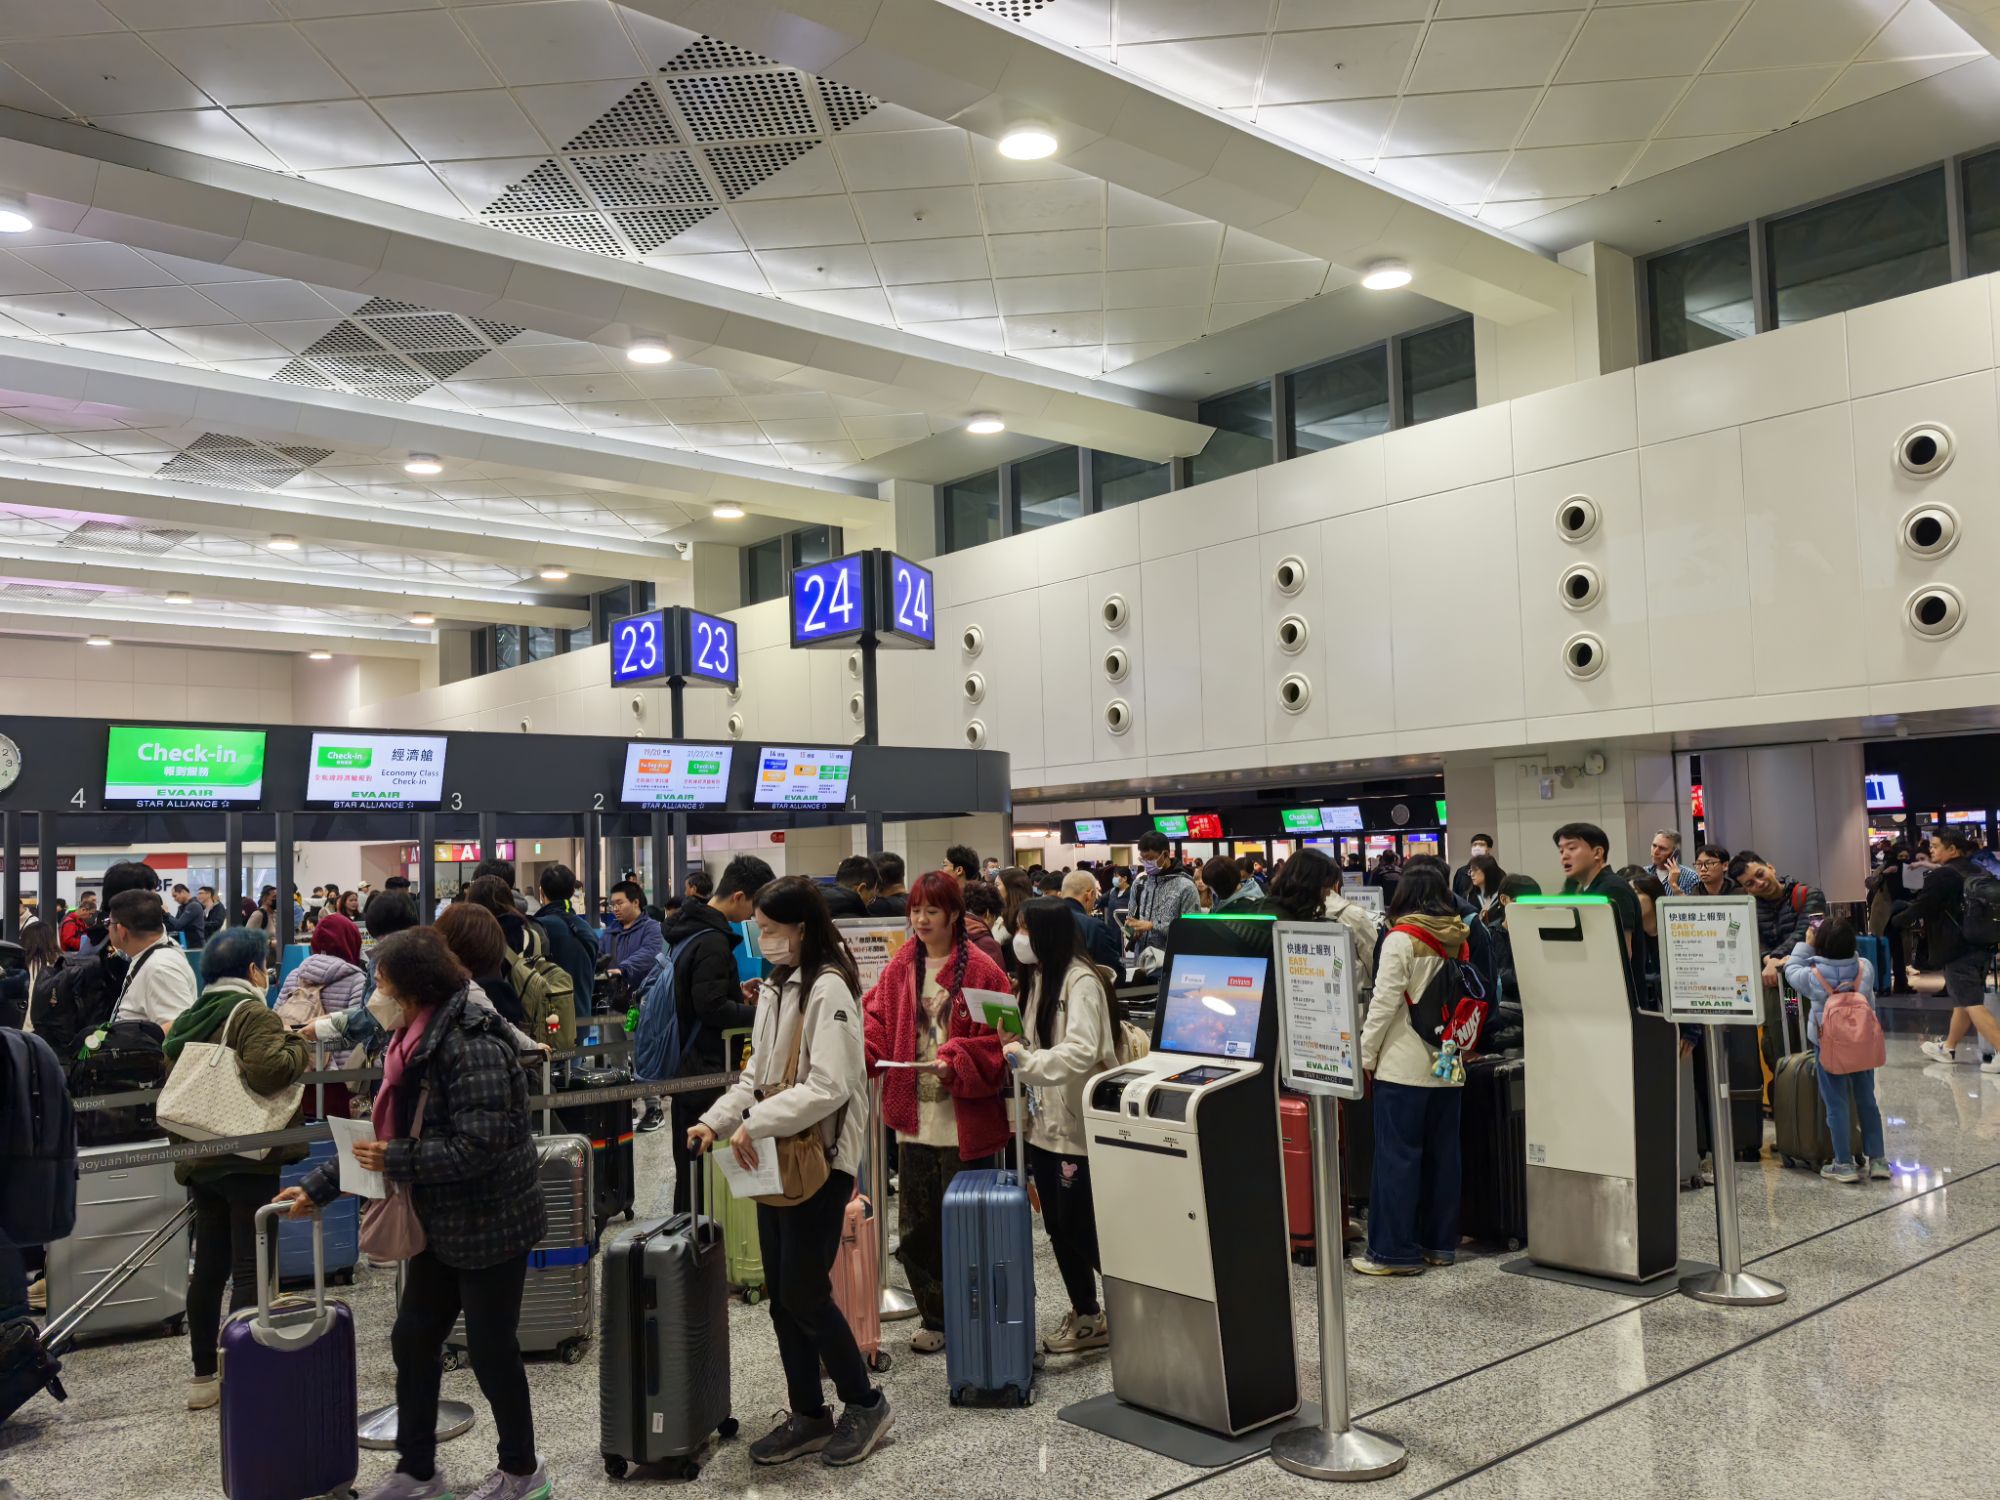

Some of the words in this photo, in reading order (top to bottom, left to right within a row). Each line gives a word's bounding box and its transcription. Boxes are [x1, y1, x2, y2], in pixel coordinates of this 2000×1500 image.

[804, 568, 853, 632] 24
[898, 568, 928, 631] 24
[621, 621, 656, 673] 23
[698, 622, 728, 673] 23
[137, 743, 237, 763] Check-in
[327, 751, 363, 761] Check-in
[391, 748, 434, 762] 經濟艙
[381, 769, 417, 778] Economy
[419, 769, 439, 777] Class
[70, 788, 86, 808] 4
[190, 789, 213, 797] AIR
[137, 800, 163, 808] STAR
[166, 800, 218, 808] ALLIANCE
[334, 801, 357, 809] STAR
[360, 801, 404, 809] ALLIANCE
[451, 792, 462, 810] 3
[593, 793, 604, 810] 2
[850, 795, 857, 809] 1
[461, 844, 507, 860] AM
[1288, 956, 1308, 965] EASY
[1289, 967, 1325, 977] CHECK-IN
[1456, 1005, 1481, 1046] NIKE
[553, 1050, 576, 1058] Airport
[1306, 1061, 1322, 1069] EVA
[1323, 1063, 1339, 1072] AIR
[620, 1087, 645, 1096] Taiwan
[649, 1083, 680, 1095] Taoyuan
[680, 1078, 726, 1091] International
[73, 1098, 105, 1109] Airport
[78, 1157, 122, 1172] aoyuan
[125, 1145, 198, 1163] International
[200, 1141, 240, 1156] Airport
